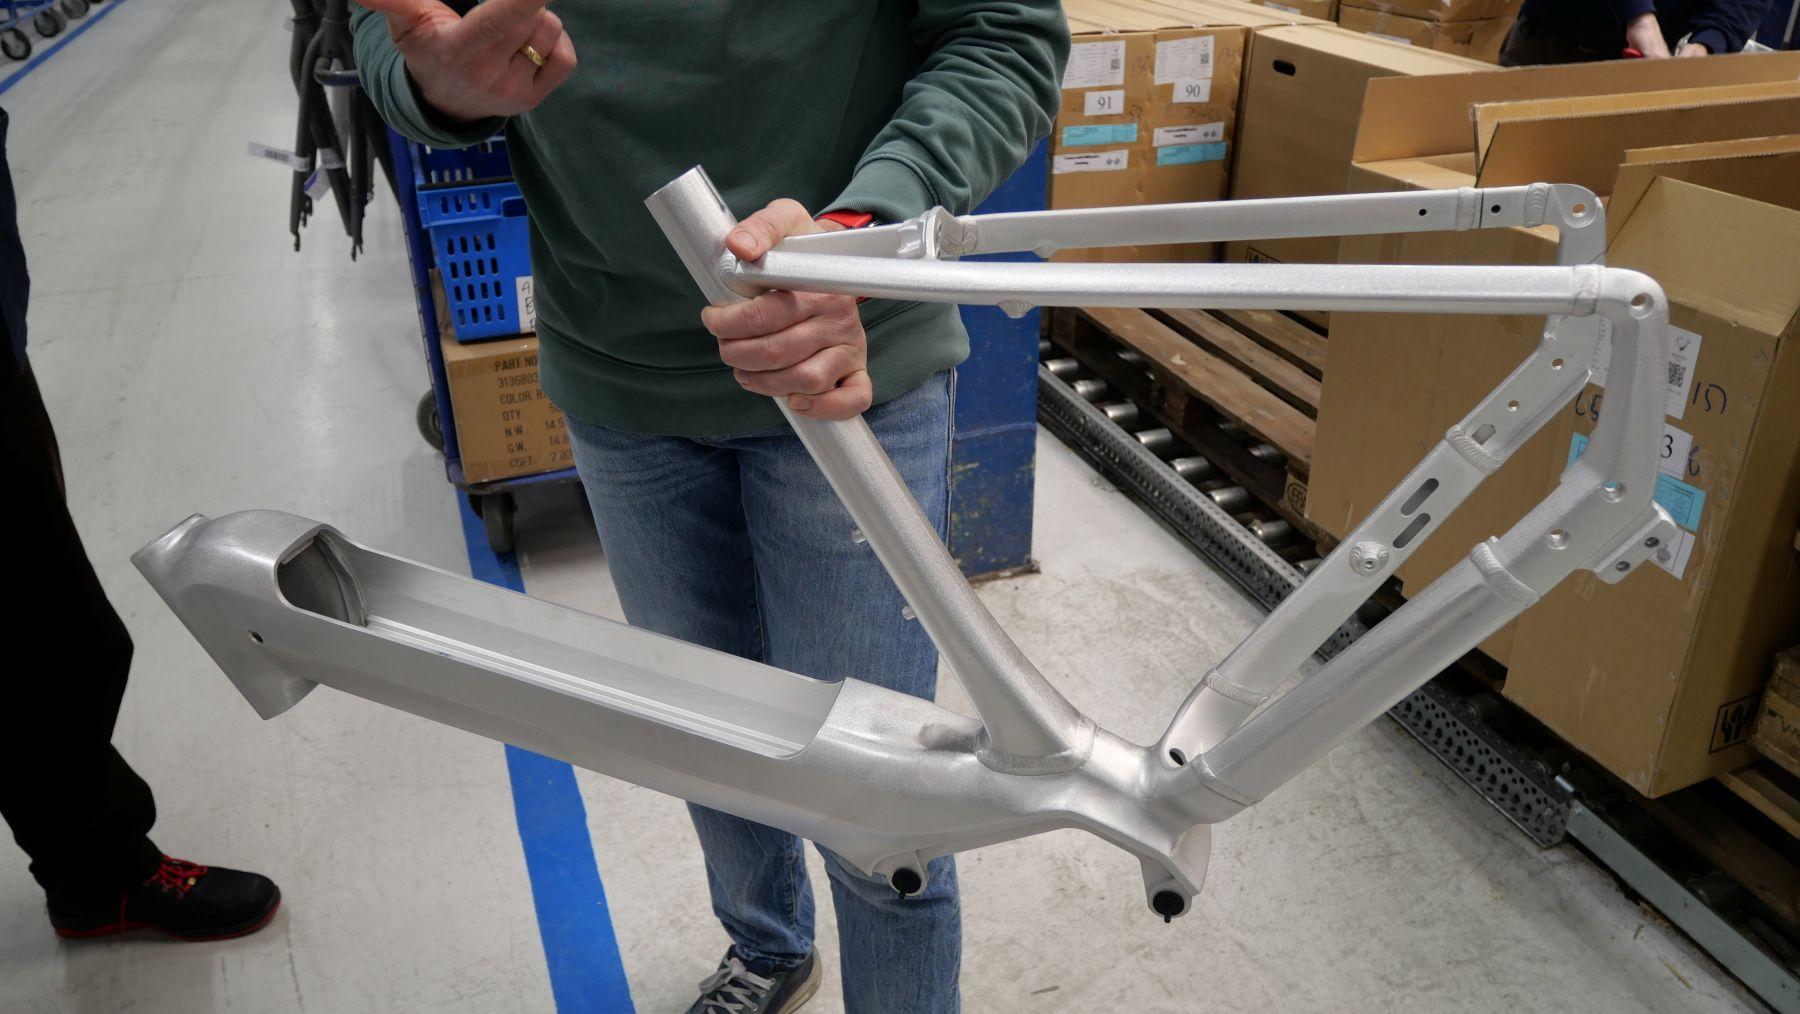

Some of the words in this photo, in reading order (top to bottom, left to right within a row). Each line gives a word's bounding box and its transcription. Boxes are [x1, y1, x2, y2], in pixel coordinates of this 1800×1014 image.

[1185, 84, 1200, 97] 90
[1098, 96, 1111, 110] 91
[494, 358, 520, 372] PART
[499, 390, 531, 405] COLOR
